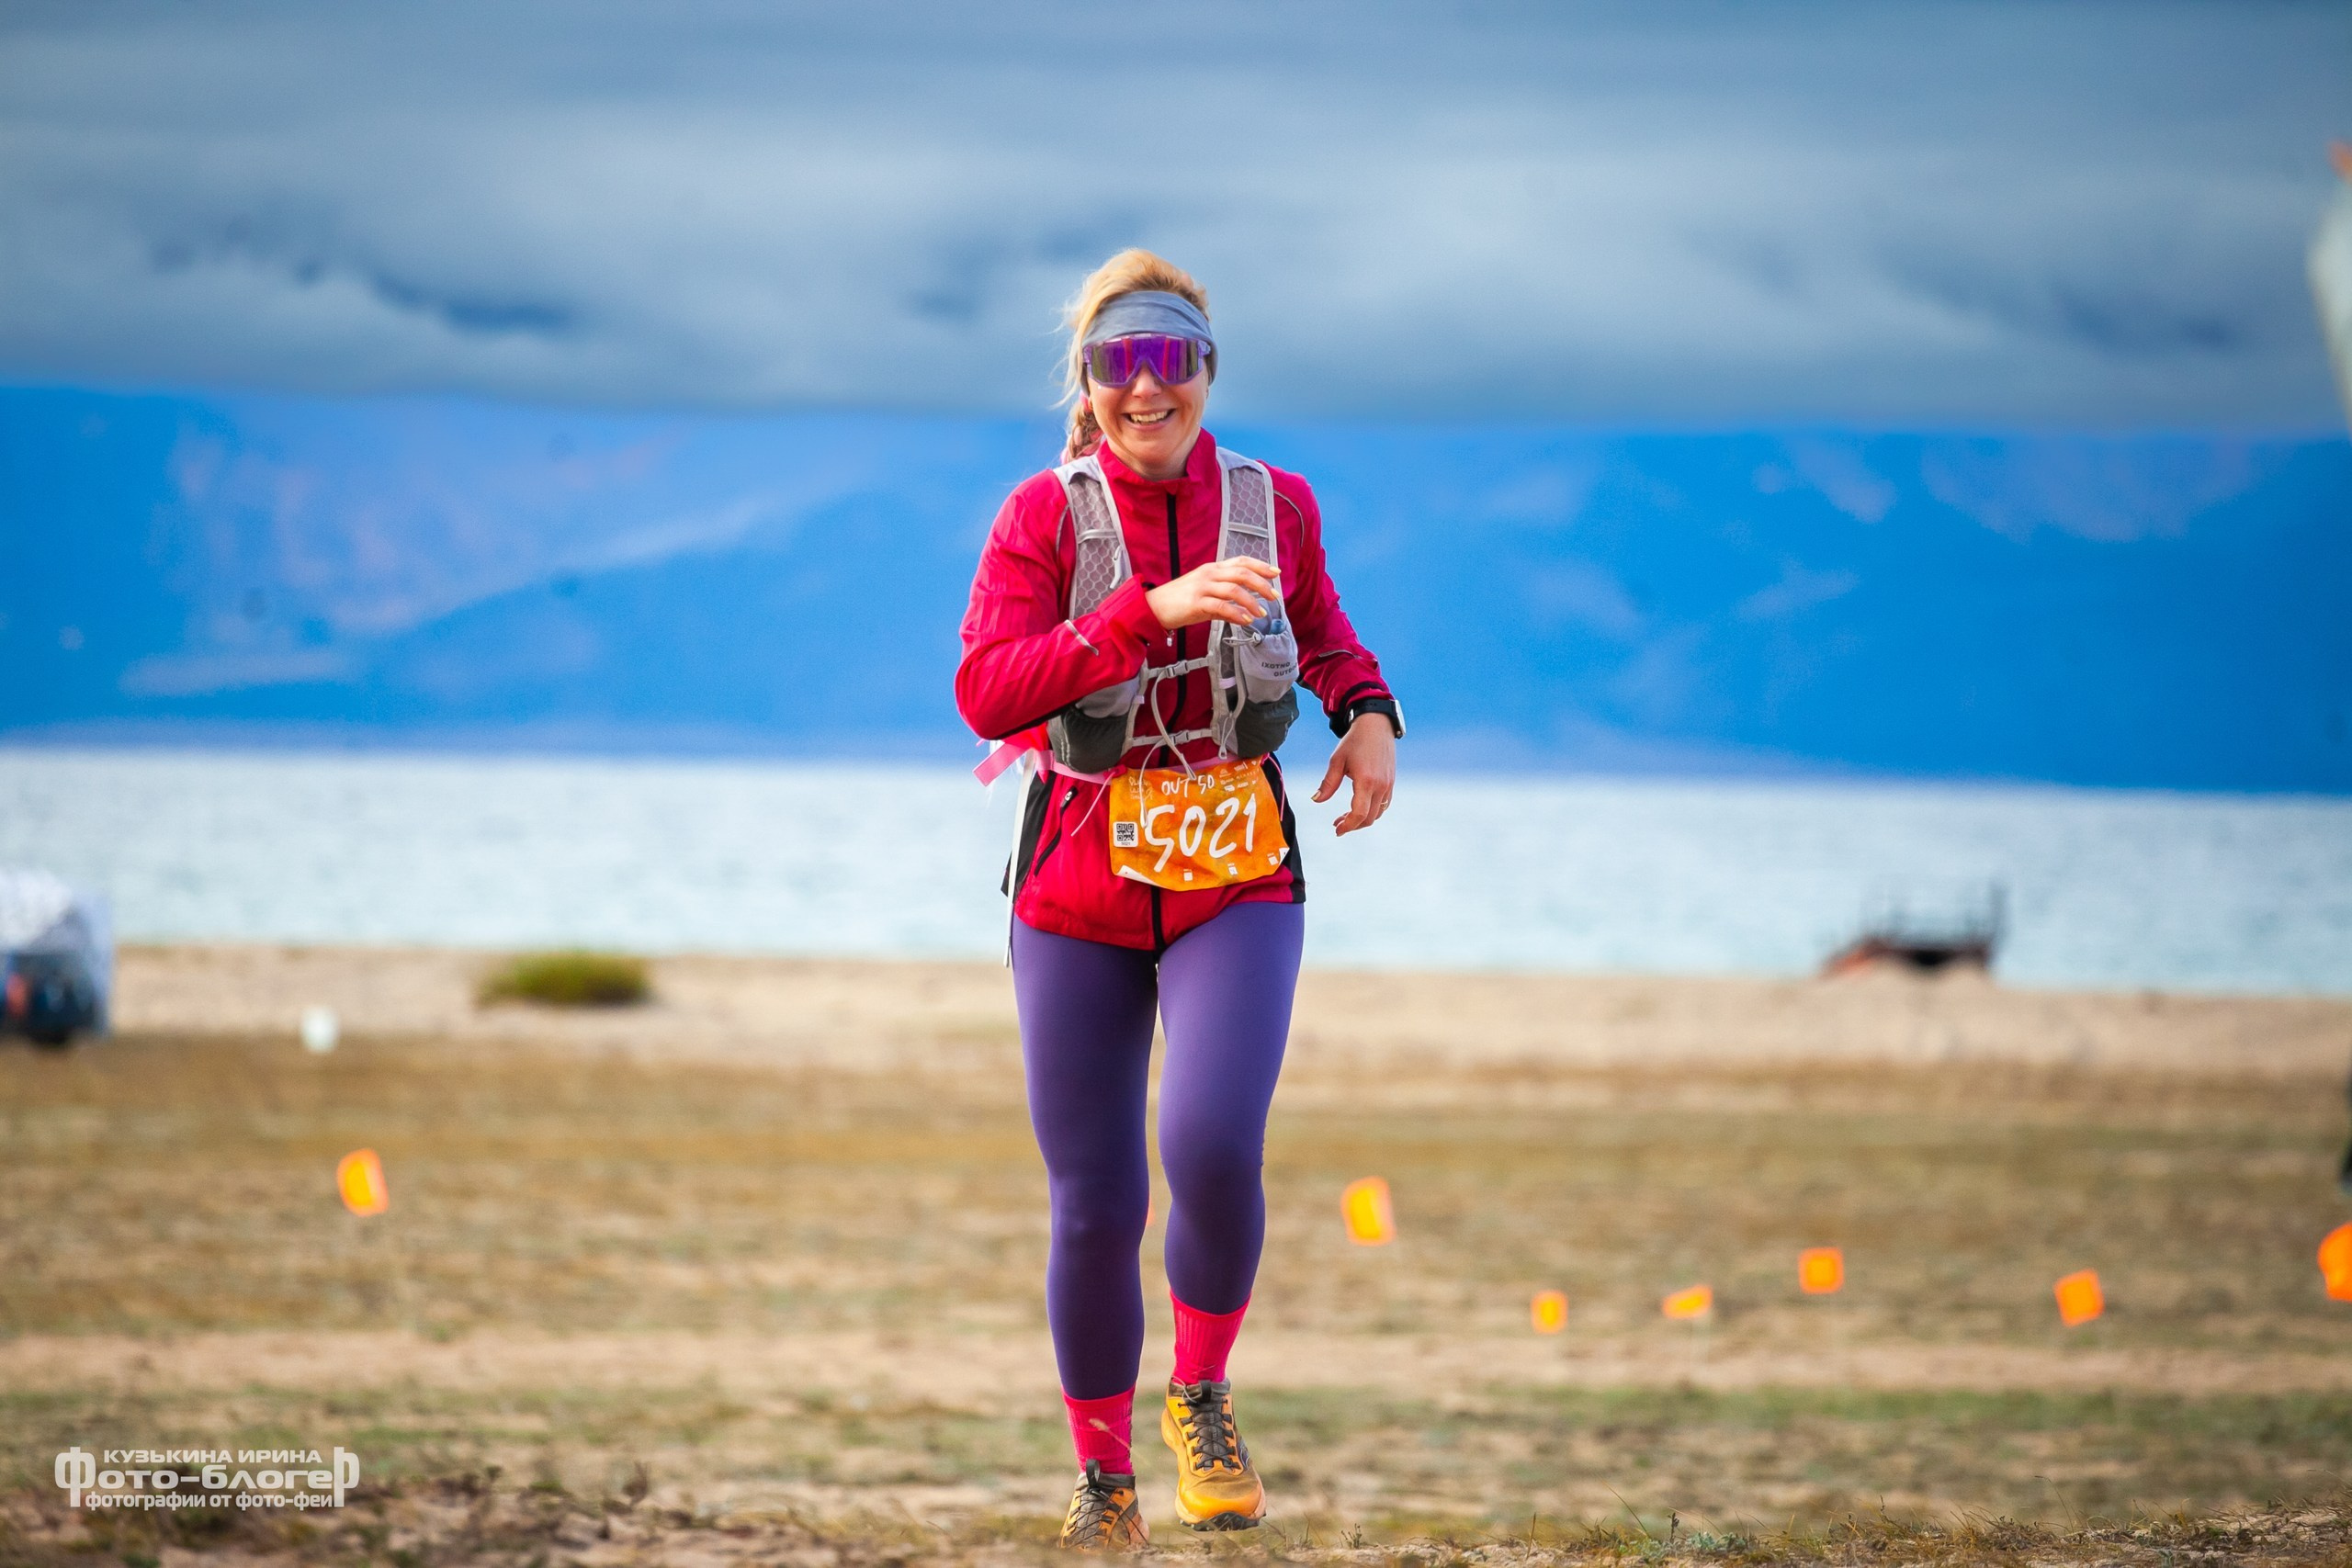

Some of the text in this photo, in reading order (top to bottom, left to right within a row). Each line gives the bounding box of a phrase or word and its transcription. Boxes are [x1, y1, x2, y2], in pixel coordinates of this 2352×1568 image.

[1161, 777, 1189, 797] OUT
[1197, 775, 1215, 794] 50
[1145, 794, 1257, 873] 5021
